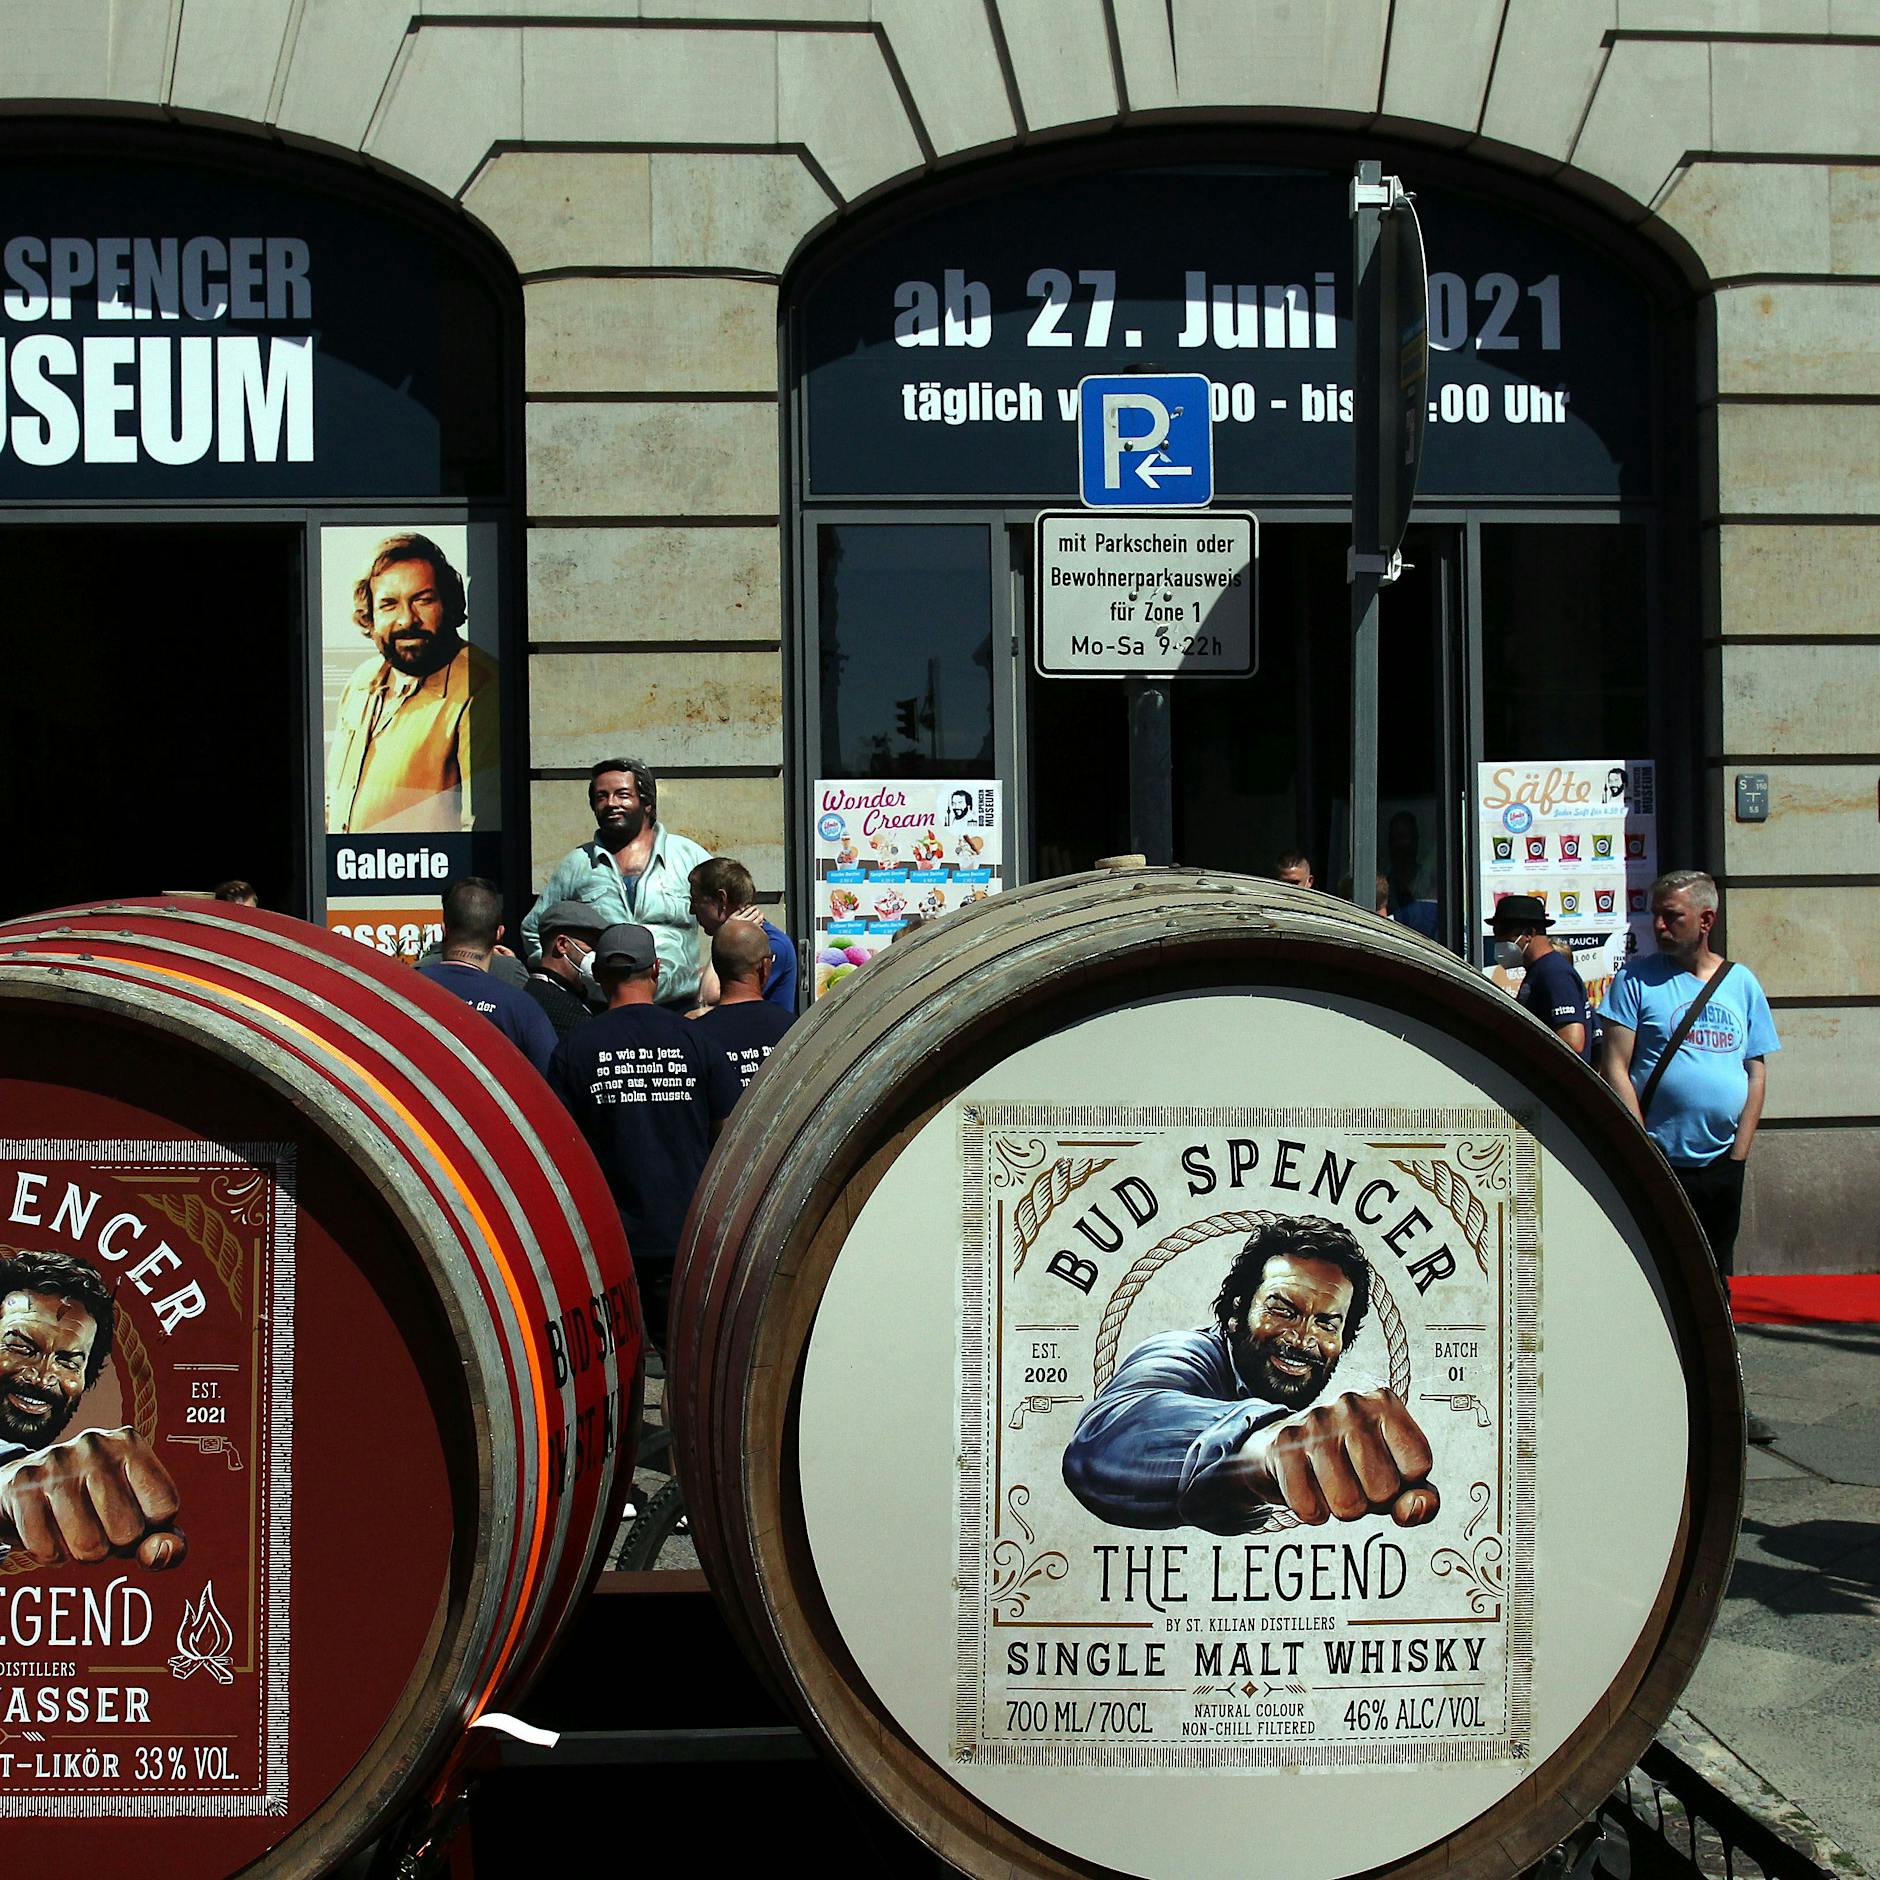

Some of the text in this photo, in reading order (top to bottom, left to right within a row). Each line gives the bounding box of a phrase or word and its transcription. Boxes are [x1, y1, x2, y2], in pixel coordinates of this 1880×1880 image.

[3, 236, 312, 322] SPENCER
[894, 269, 1562, 351] ab 27. Juni 021
[0, 334, 314, 466] SEUM
[901, 382, 1043, 424] täglich
[1213, 382, 1256, 423] 00
[1301, 382, 1354, 423] bis
[1428, 383, 1490, 424] :00
[1504, 382, 1568, 424] Uhr
[1104, 394, 1170, 489] P
[1058, 533, 1235, 554] mit Parkschein oder
[1051, 567, 1242, 594] Bewohnerparkausweis
[1110, 602, 1201, 622] für Zone 1
[1071, 636, 1145, 656] Mo-Sa
[1483, 767, 1592, 816] Säfte
[1642, 766, 1653, 814] MUSEUM
[1739, 779, 1747, 790] S
[822, 786, 906, 812] Wonder
[985, 789, 994, 827] MUSEUM
[863, 809, 935, 837] Cream
[336, 848, 449, 880] Galerie
[1569, 937, 1599, 946] RAUCH
[1684, 1029, 1734, 1049] MOTORS
[599, 1047, 684, 1063] So wie Du jetzt,
[741, 1048, 759, 1060] wie
[596, 1062, 688, 1077] so sah mein Opa
[652, 1077, 682, 1088] wenn
[685, 1077, 697, 1087] er
[651, 1091, 692, 1102] musste.
[1046, 1138, 1459, 1296] BUD SPENCER
[546, 1274, 640, 1388] BUD SPEN
[1032, 1343, 1060, 1359] EST.
[1434, 1342, 1478, 1358] BATCH
[1024, 1367, 1068, 1383] 2020
[1448, 1366, 1465, 1382] 01
[191, 1382, 221, 1399] EST.
[186, 1406, 226, 1423] 2021
[1093, 1532, 1407, 1613] THE LEGEND
[0, 1576, 152, 1646] GEND
[1166, 1616, 1336, 1632] BY ST. KILIAN DISTILLERS
[1006, 1637, 1487, 1677] SINGLE MALT WHISKY
[0, 1686, 151, 1723] ASSER
[1006, 1701, 1048, 1733] 700
[1194, 1703, 1305, 1718] NATURAL COLOUR
[1343, 1696, 1486, 1731] 46% ALC/VOL
[1181, 1720, 1316, 1736] NON-CHILL FILTERED
[194, 1747, 240, 1780] VOL.
